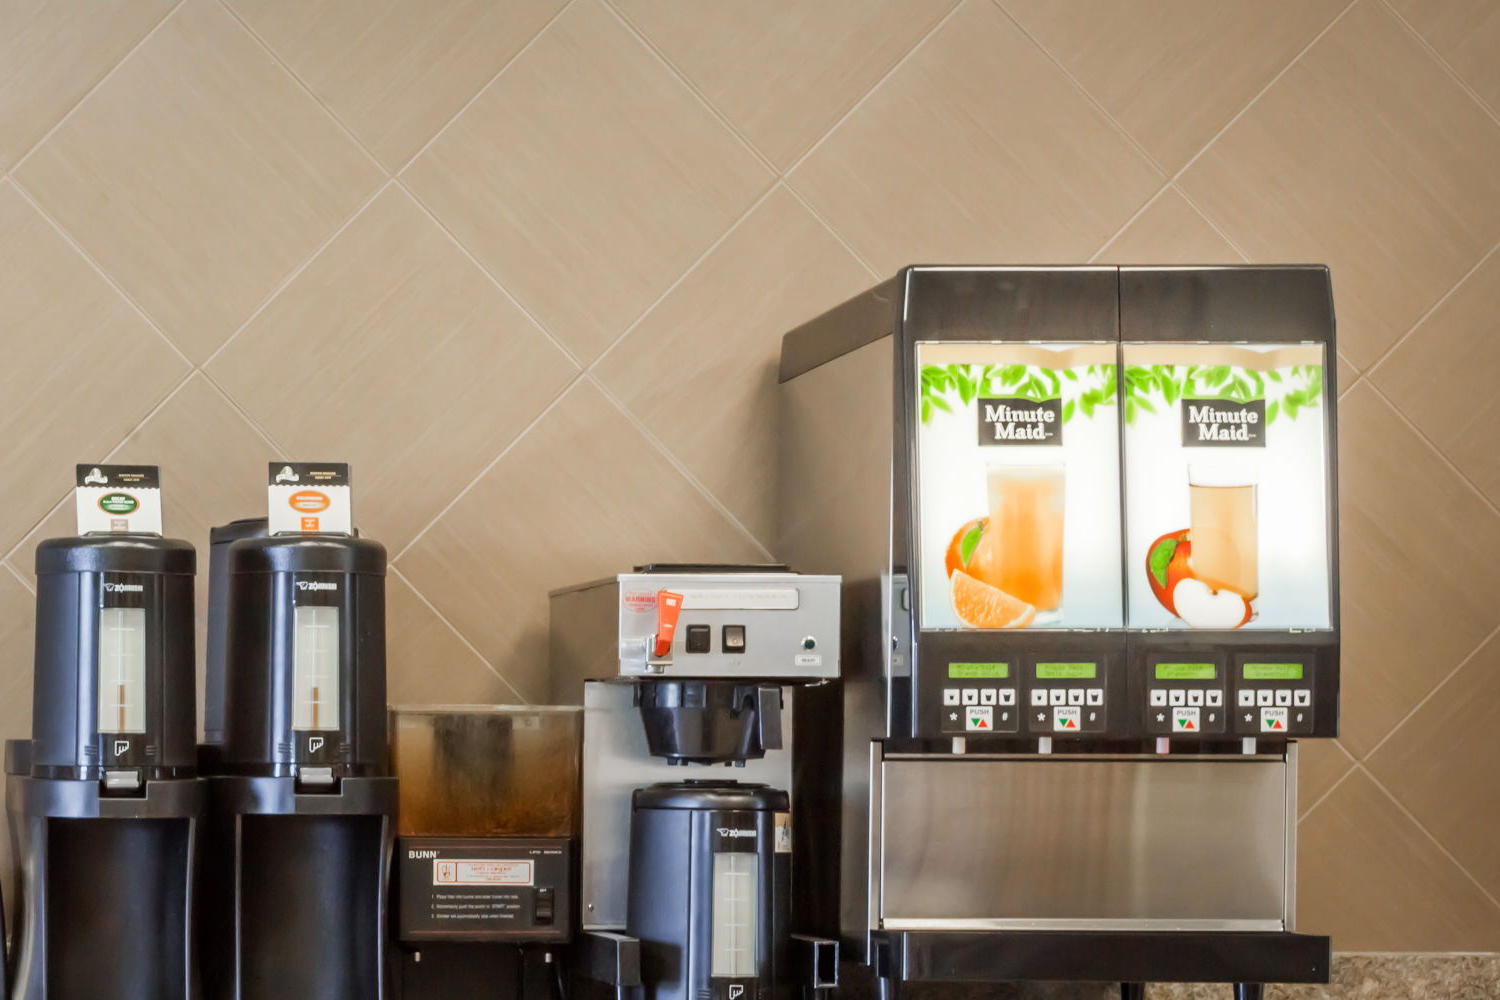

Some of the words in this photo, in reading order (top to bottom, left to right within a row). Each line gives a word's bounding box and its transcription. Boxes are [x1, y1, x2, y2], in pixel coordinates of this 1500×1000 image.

[984, 404, 1056, 423] Minute
[1188, 405, 1259, 424] Minute
[994, 422, 1046, 440] Maid
[1198, 423, 1249, 441] Maid
[408, 850, 437, 859] BUNN
